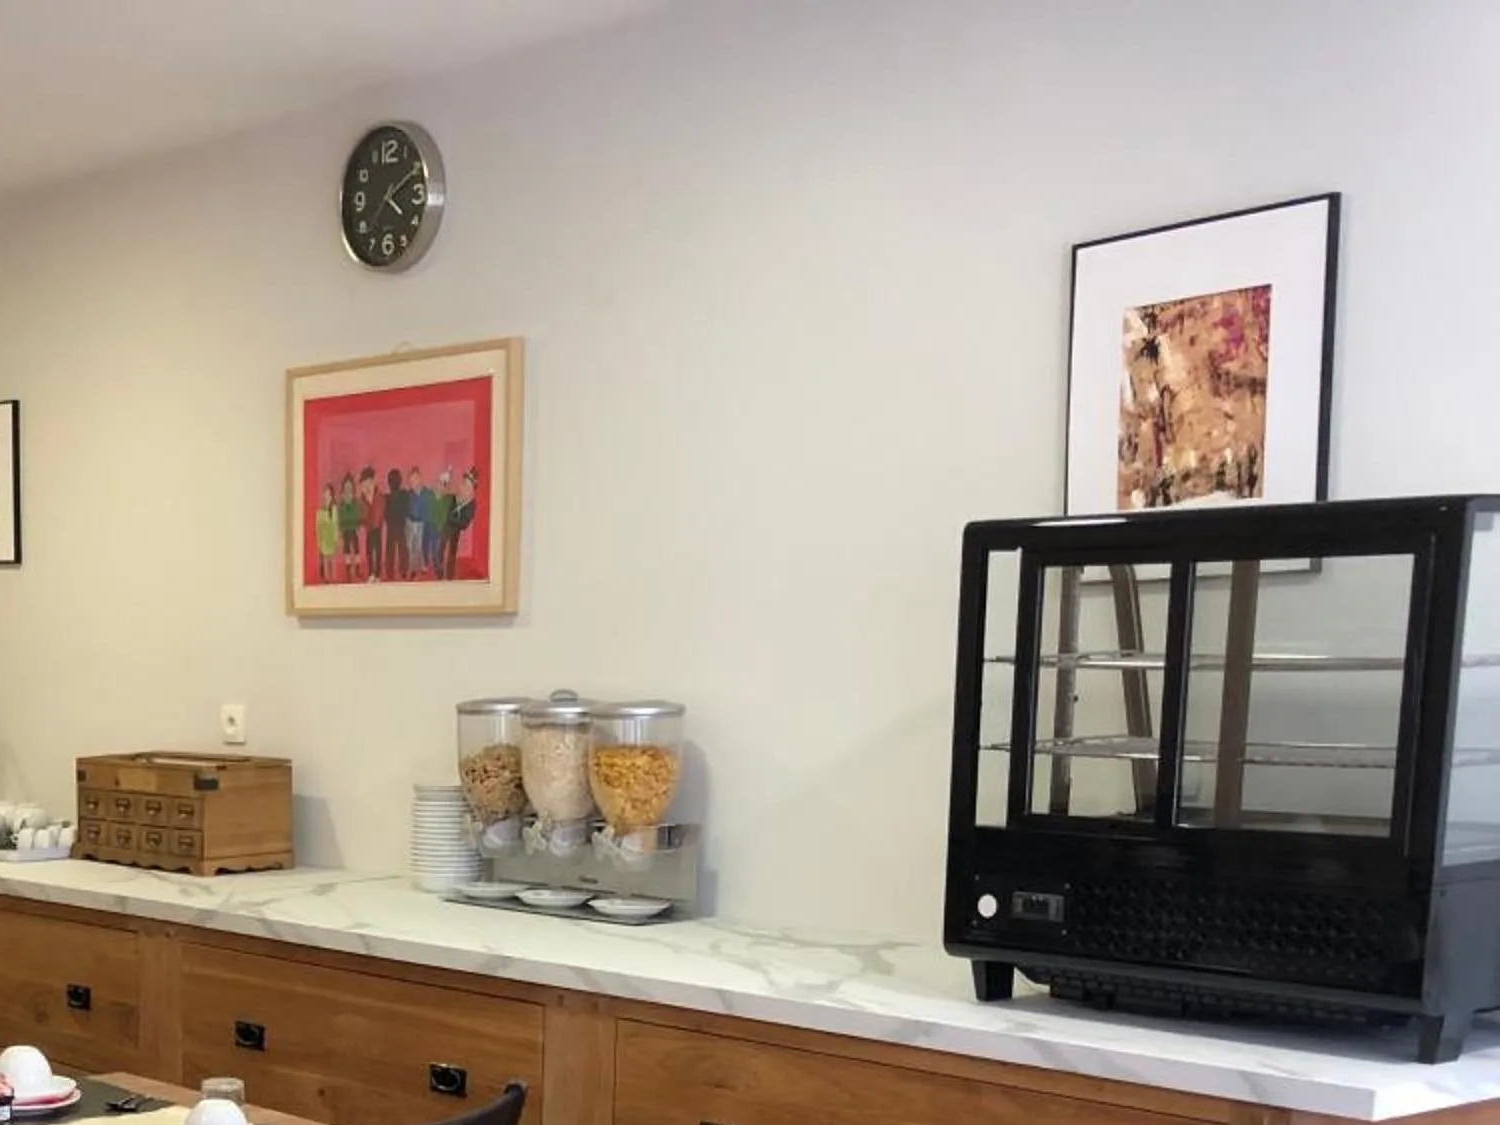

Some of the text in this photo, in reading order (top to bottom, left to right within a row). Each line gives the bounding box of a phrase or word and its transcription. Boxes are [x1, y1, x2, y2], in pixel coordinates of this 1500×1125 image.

[381, 139, 399, 165] 12
[354, 191, 366, 212] 9
[411, 184, 424, 205] 3
[411, 215, 419, 225] 4
[369, 238, 376, 250] 7
[382, 233, 395, 255] 6
